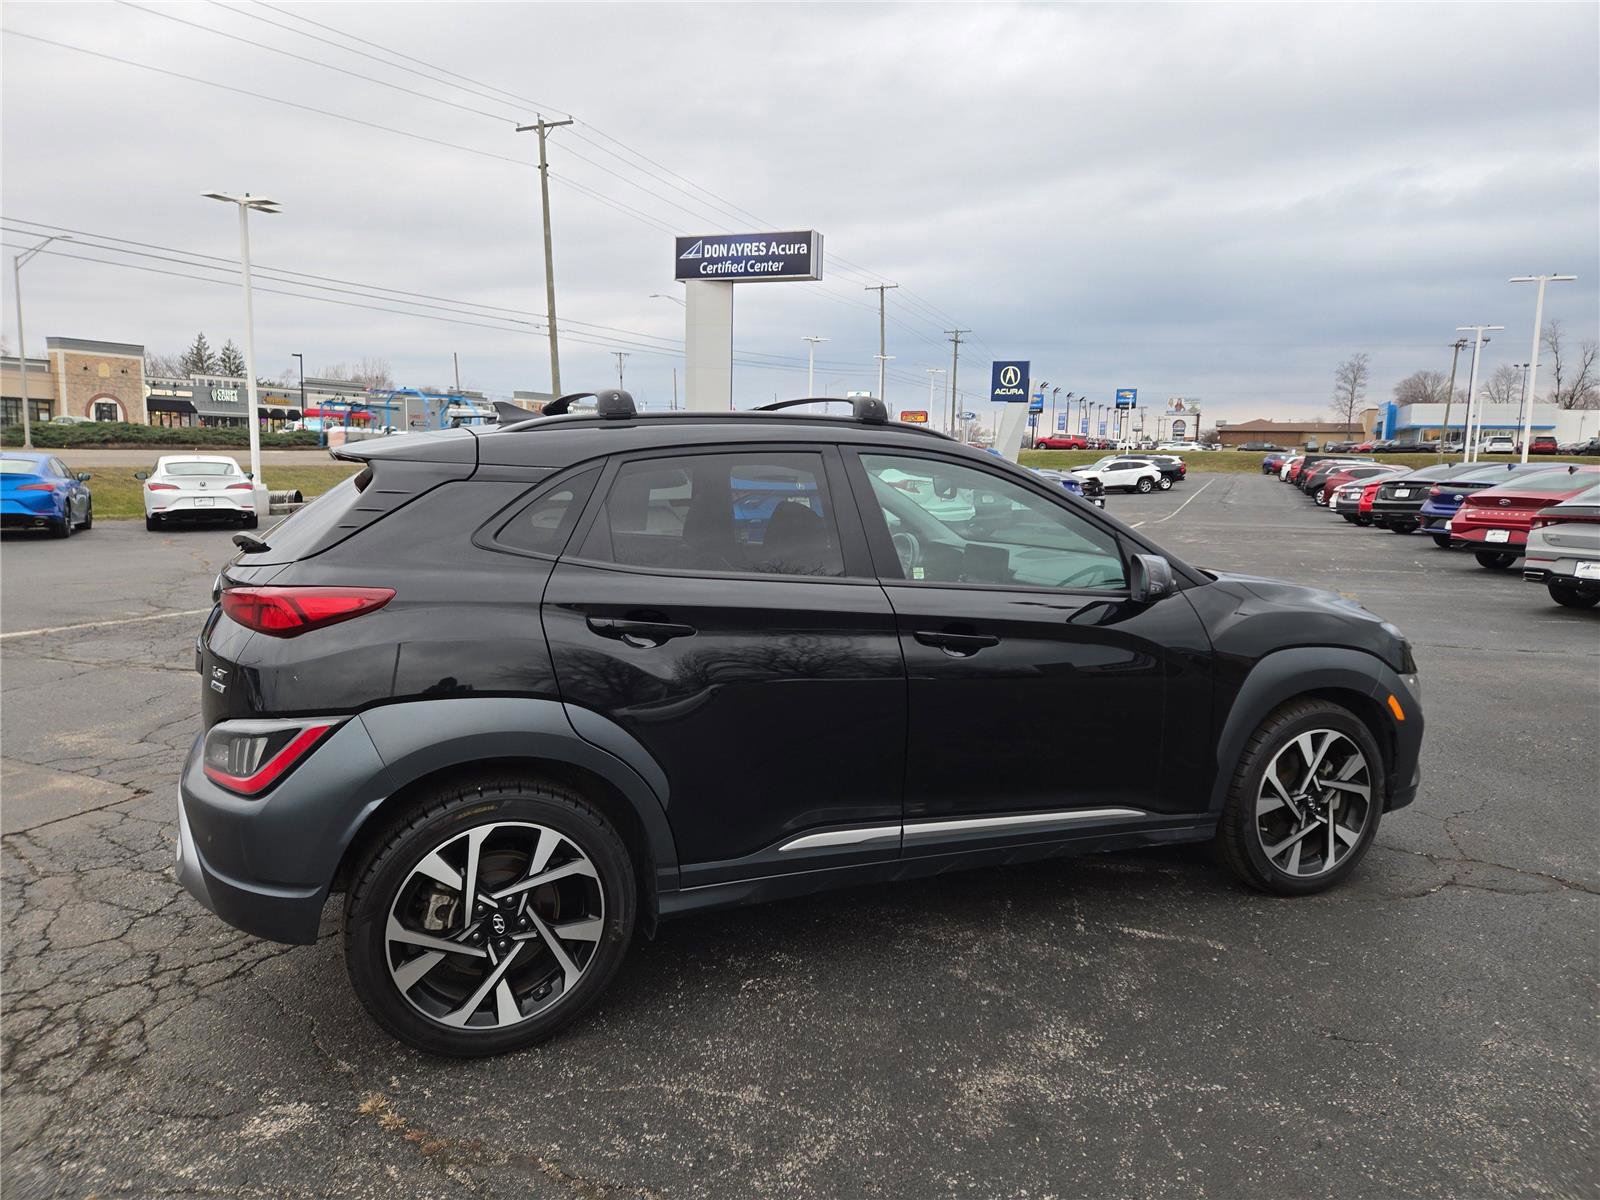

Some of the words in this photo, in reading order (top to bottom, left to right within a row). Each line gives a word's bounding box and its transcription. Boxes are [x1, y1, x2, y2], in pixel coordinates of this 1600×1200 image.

[704, 244, 727, 258] DON
[729, 242, 766, 257] AYRES
[769, 241, 808, 255] Acura
[700, 260, 745, 274] Certified
[747, 260, 784, 272] Center
[217, 388, 238, 396] CRISPY
